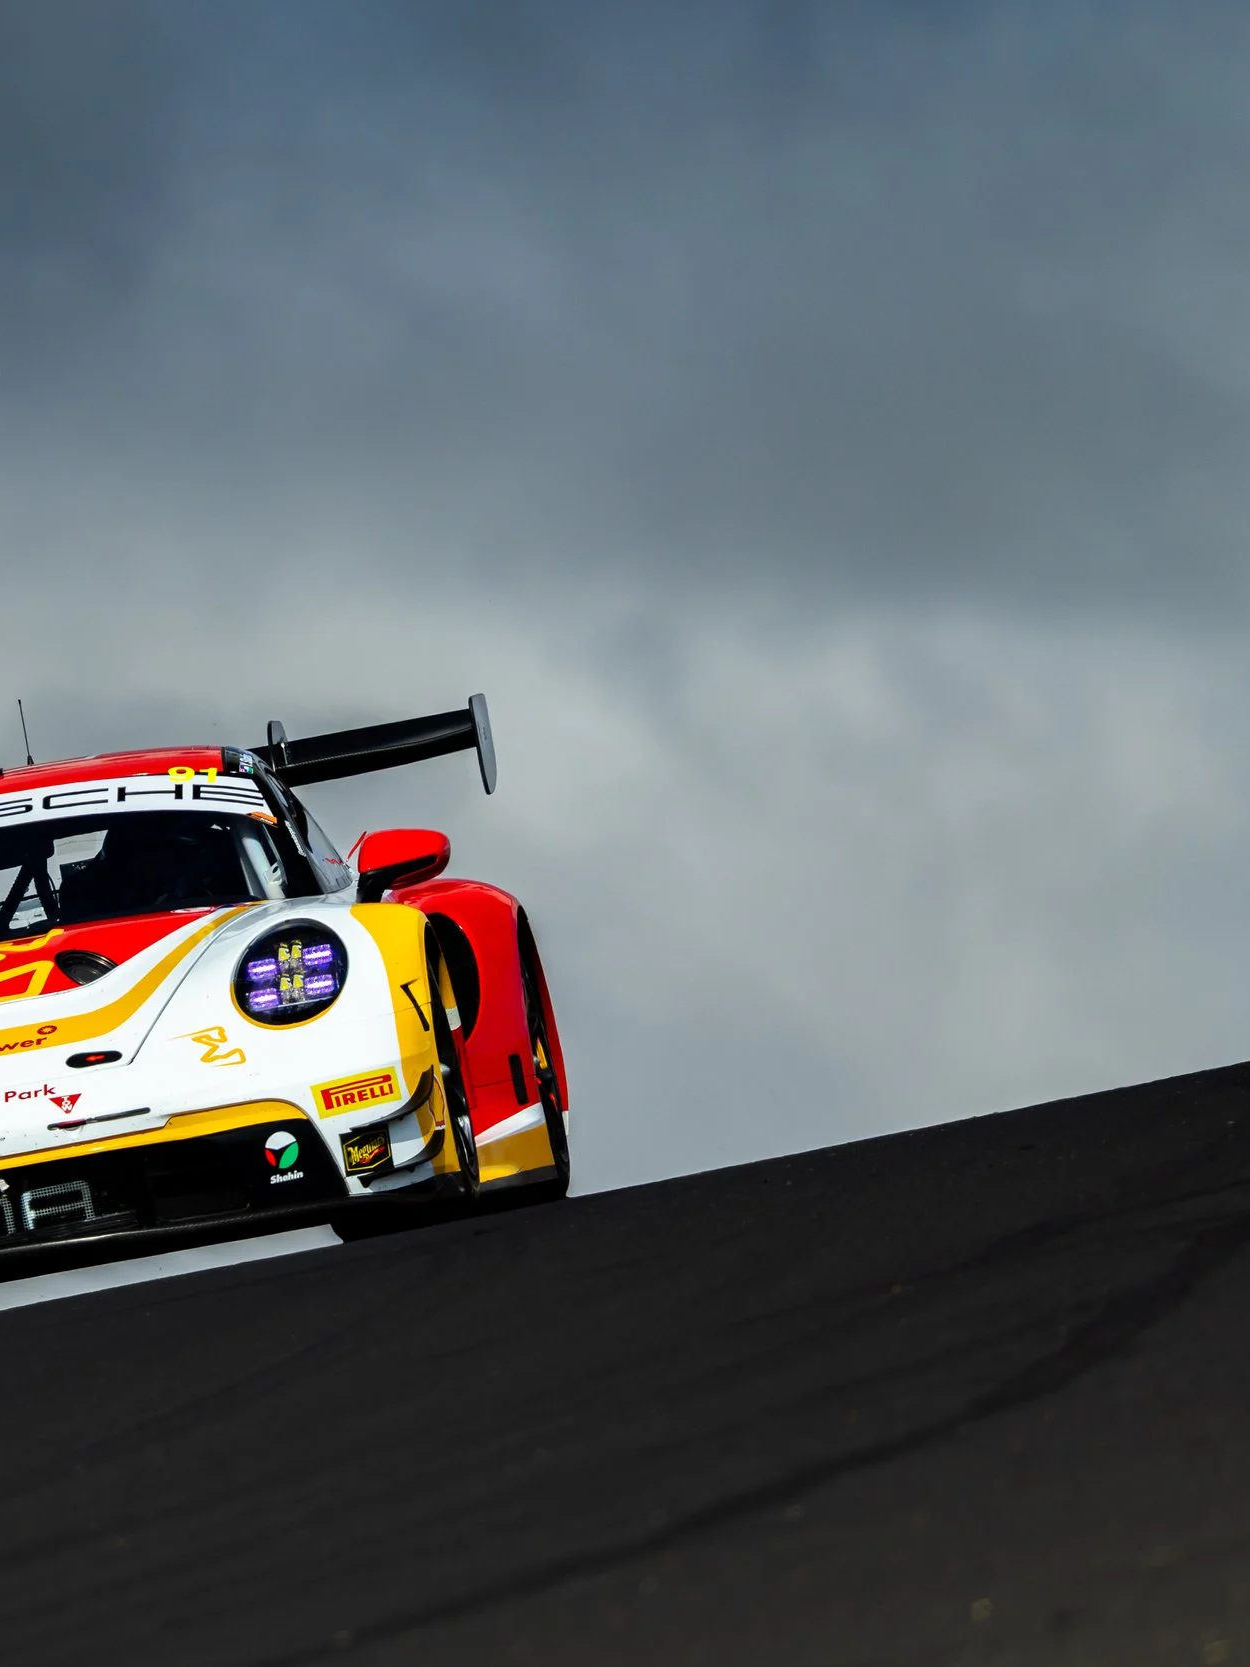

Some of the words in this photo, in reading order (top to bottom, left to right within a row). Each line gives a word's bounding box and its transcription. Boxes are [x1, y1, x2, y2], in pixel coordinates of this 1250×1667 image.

[167, 766, 218, 783] 91
[4, 1084, 56, 1102] Park
[321, 1074, 394, 1110] PIRELLI
[61, 1096, 73, 1112] TOW
[270, 1170, 304, 1184] Shahin
